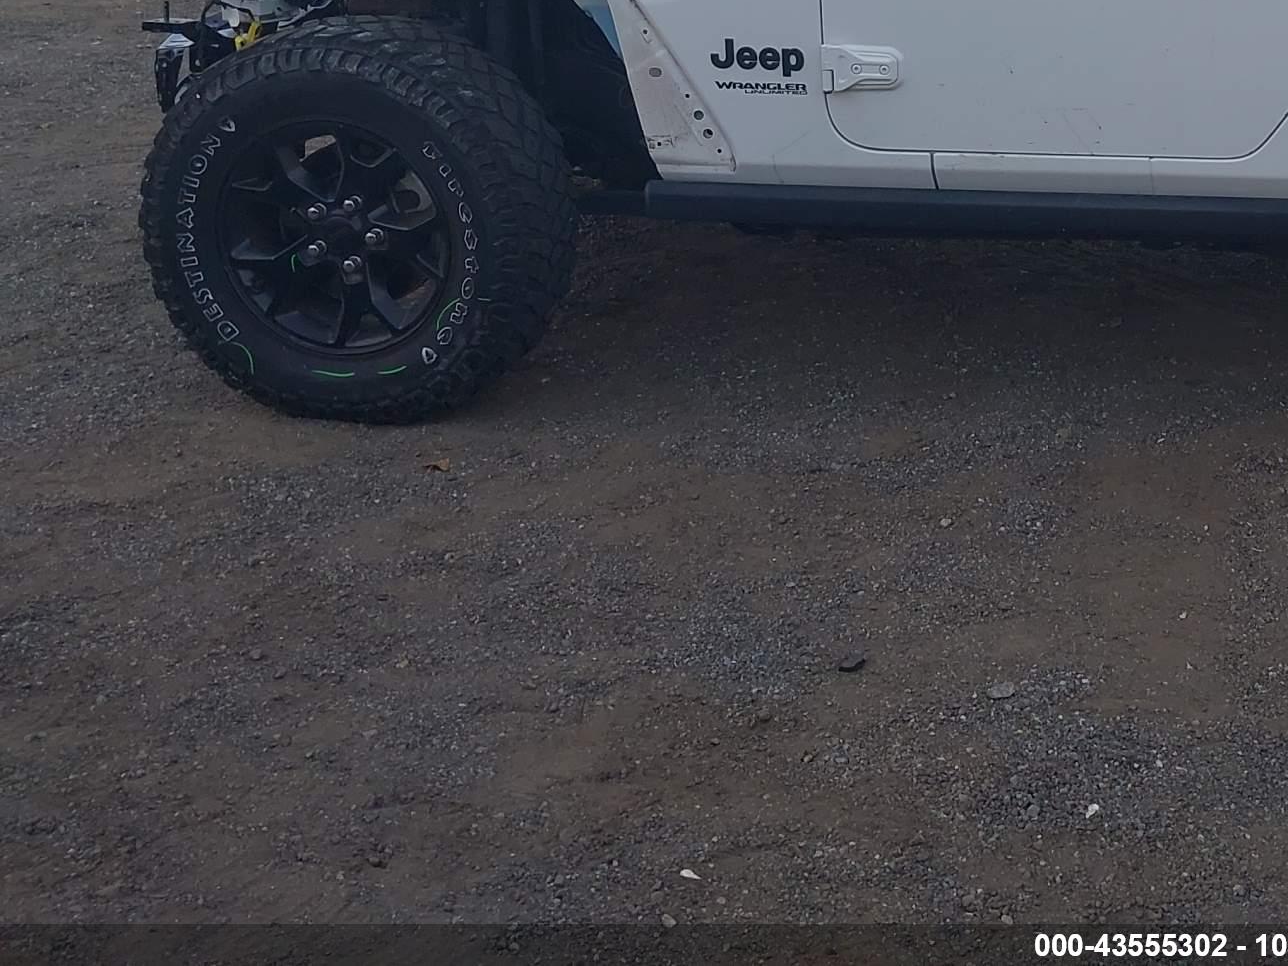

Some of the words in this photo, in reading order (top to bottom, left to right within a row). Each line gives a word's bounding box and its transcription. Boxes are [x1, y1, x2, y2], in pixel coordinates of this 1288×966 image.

[710, 38, 805, 78] Jeep
[714, 81, 807, 91] WRANGLER
[176, 132, 240, 342] DESTINATION
